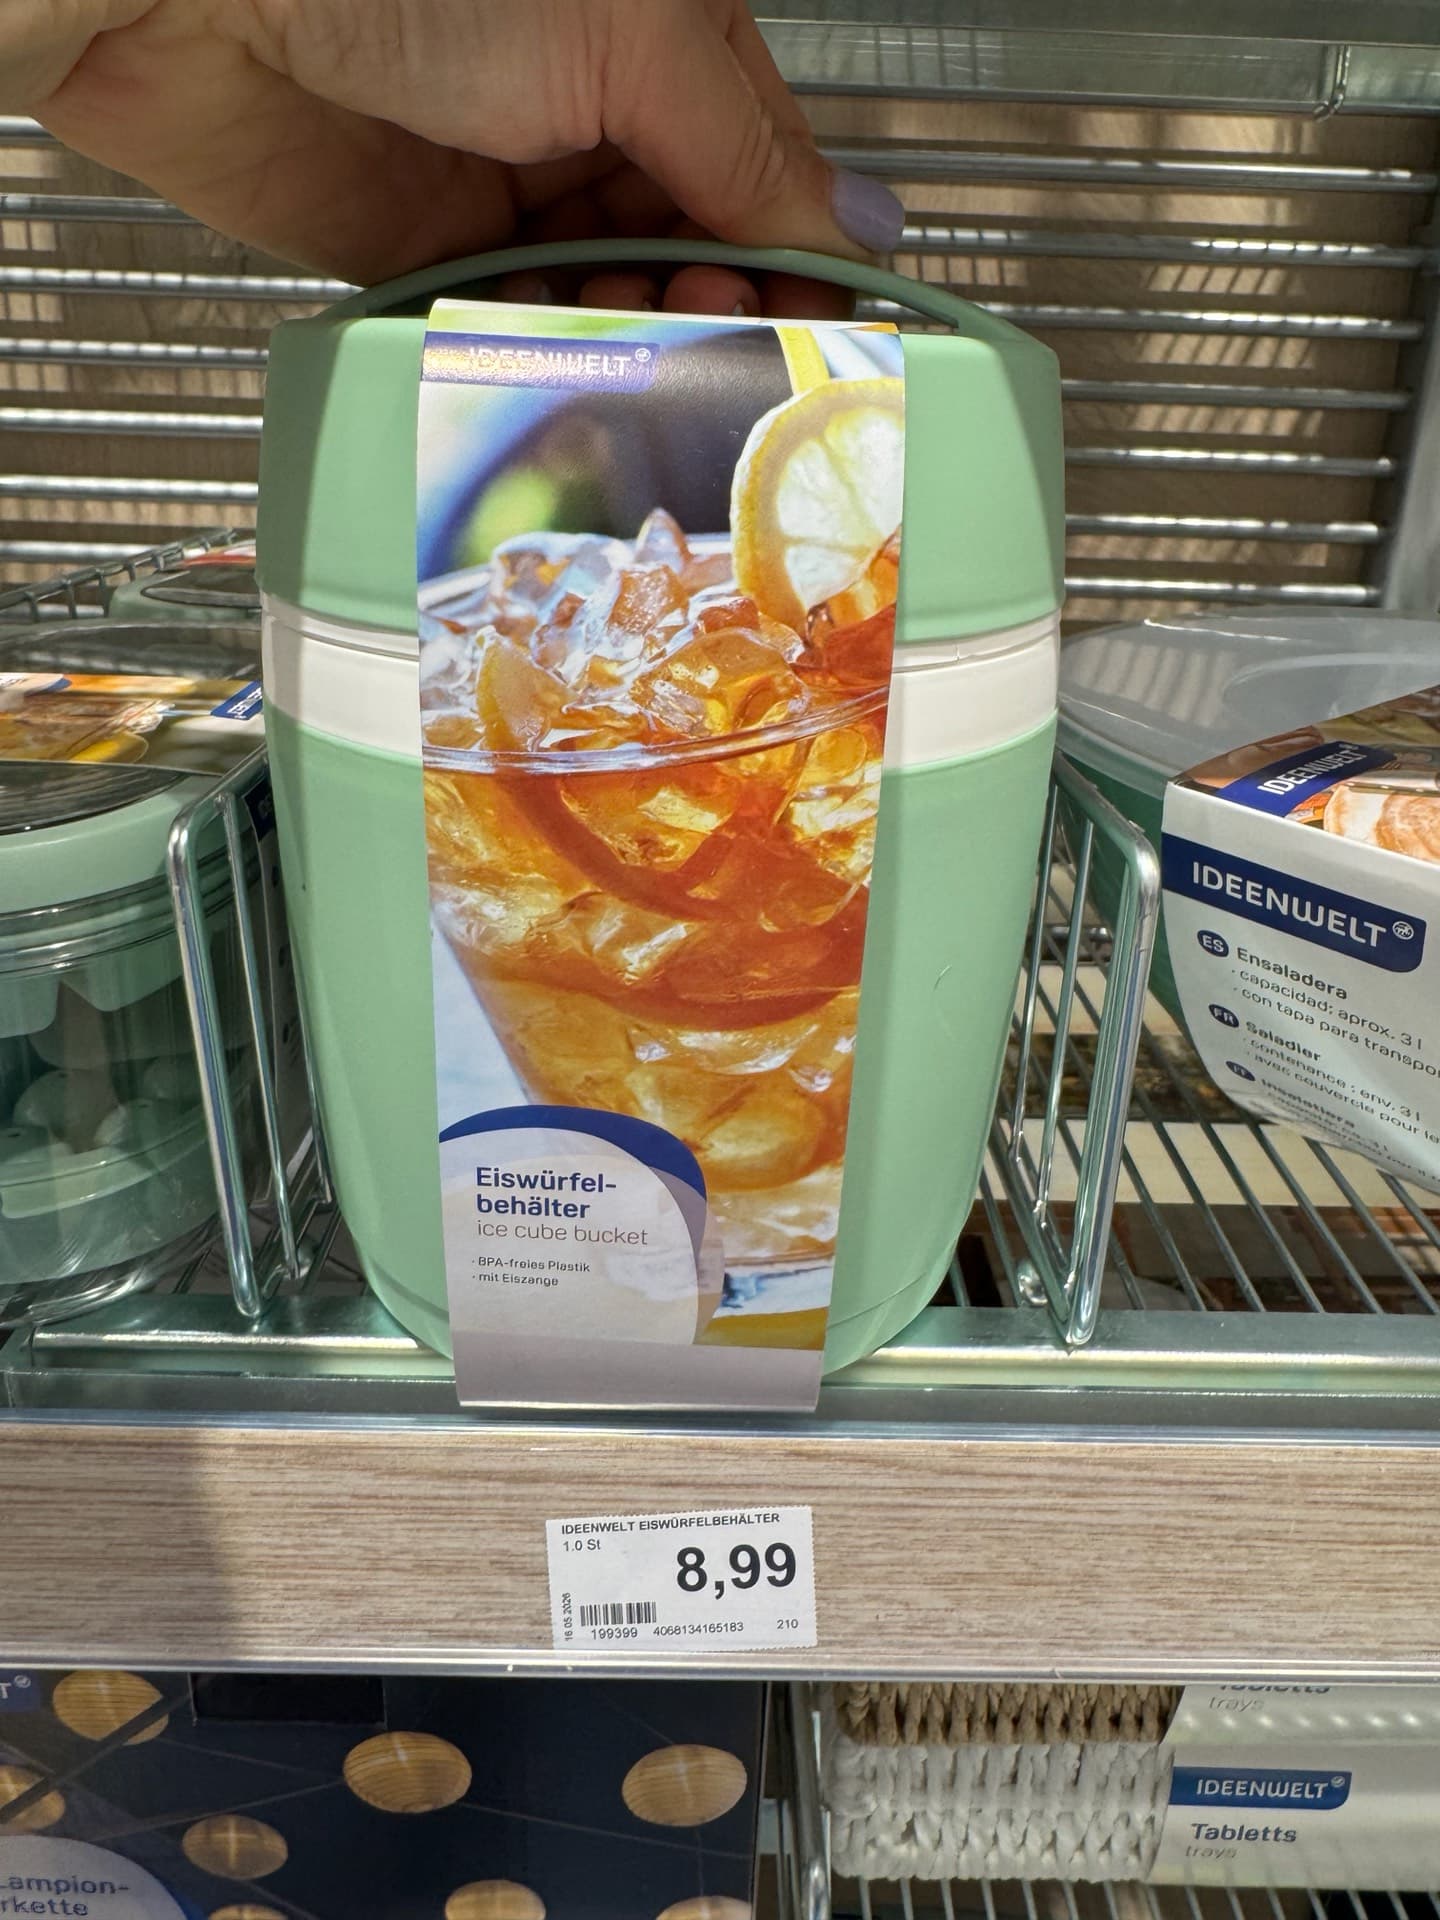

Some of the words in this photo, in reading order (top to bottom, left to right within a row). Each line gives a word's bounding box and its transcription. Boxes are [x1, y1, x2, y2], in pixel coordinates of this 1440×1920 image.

[469, 346, 632, 377] IDEENWELT
[1257, 749, 1367, 796] IDEENWELT
[1192, 861, 1387, 948] IDEENWELT
[1202, 934, 1225, 953] ES
[1237, 946, 1347, 1000] Ensaladera
[1213, 1006, 1235, 1025] FR
[1240, 969, 1334, 1015] capacidad:
[1338, 1009, 1396, 1041] aprox.
[1400, 1031, 1412, 1047] 3
[1241, 987, 1273, 1009] con
[1276, 1001, 1316, 1026] tapa
[1319, 1020, 1360, 1044] para
[1246, 1020, 1322, 1062] Saladier
[1360, 1089, 1396, 1112] env.
[1400, 1105, 1412, 1118] 3
[1379, 1111, 1420, 1135] pour
[476, 1166, 617, 1193] Eiswürfel-
[477, 1193, 591, 1219] behälter
[477, 1219, 508, 1238] ice
[514, 1223, 568, 1241] cube
[574, 1225, 649, 1246] bucket
[478, 1256, 545, 1270] BPA-freies
[548, 1260, 591, 1273] Plastik
[478, 1272, 499, 1283] mit
[502, 1273, 559, 1287] Eiszange
[561, 1521, 636, 1535] IDEENWELT
[639, 1512, 780, 1531] EISWÜRFELBEHÄLTER
[563, 1540, 583, 1552] 1.0
[587, 1538, 601, 1551] St
[676, 1542, 797, 1600] 8,99
[591, 1627, 638, 1640] 199399
[653, 1622, 744, 1637] 4068134165183
[777, 1618, 798, 1630] 210
[1196, 1779, 1328, 1799] IDEENWELT
[1191, 1823, 1297, 1843] Tabletts
[1185, 1845, 1237, 1859] trays
